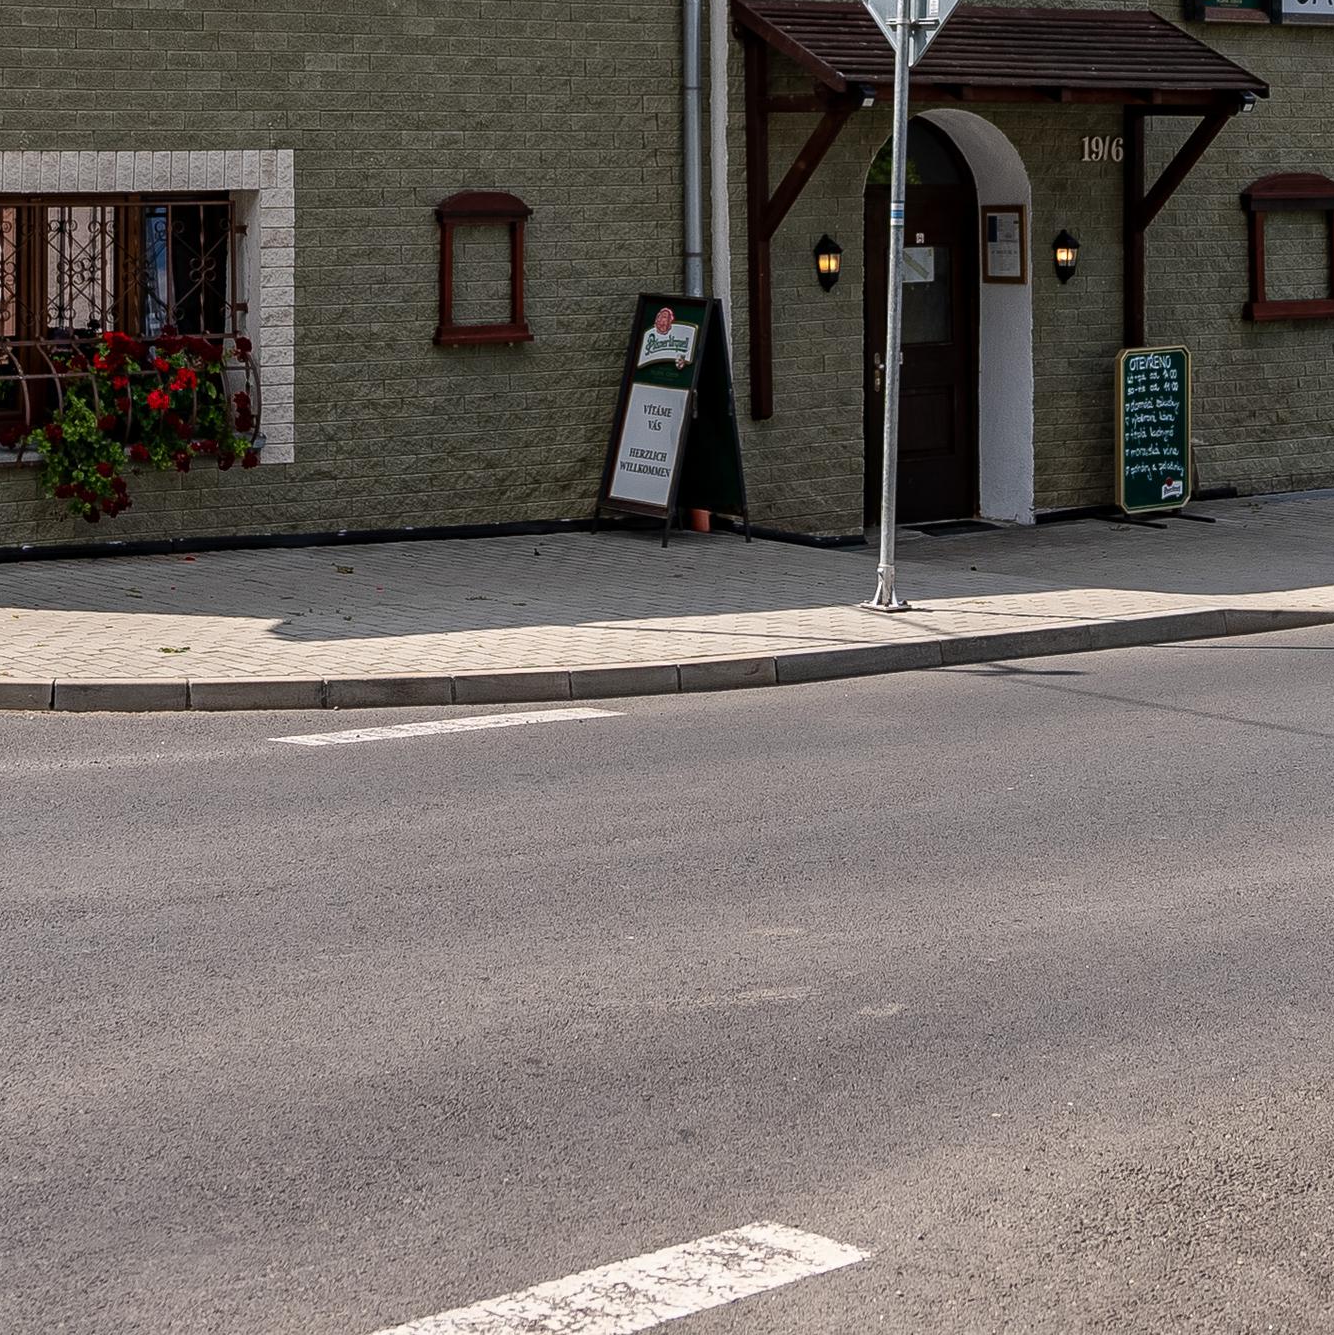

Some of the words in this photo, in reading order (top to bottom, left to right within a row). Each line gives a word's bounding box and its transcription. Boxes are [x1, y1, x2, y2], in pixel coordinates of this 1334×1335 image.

[1081, 135, 1124, 162] 19/6
[643, 404, 672, 418] VÍTÁME
[648, 419, 662, 431] VÁS
[629, 447, 667, 462] HERZLICH
[619, 460, 671, 477] WILLKOMMEN
